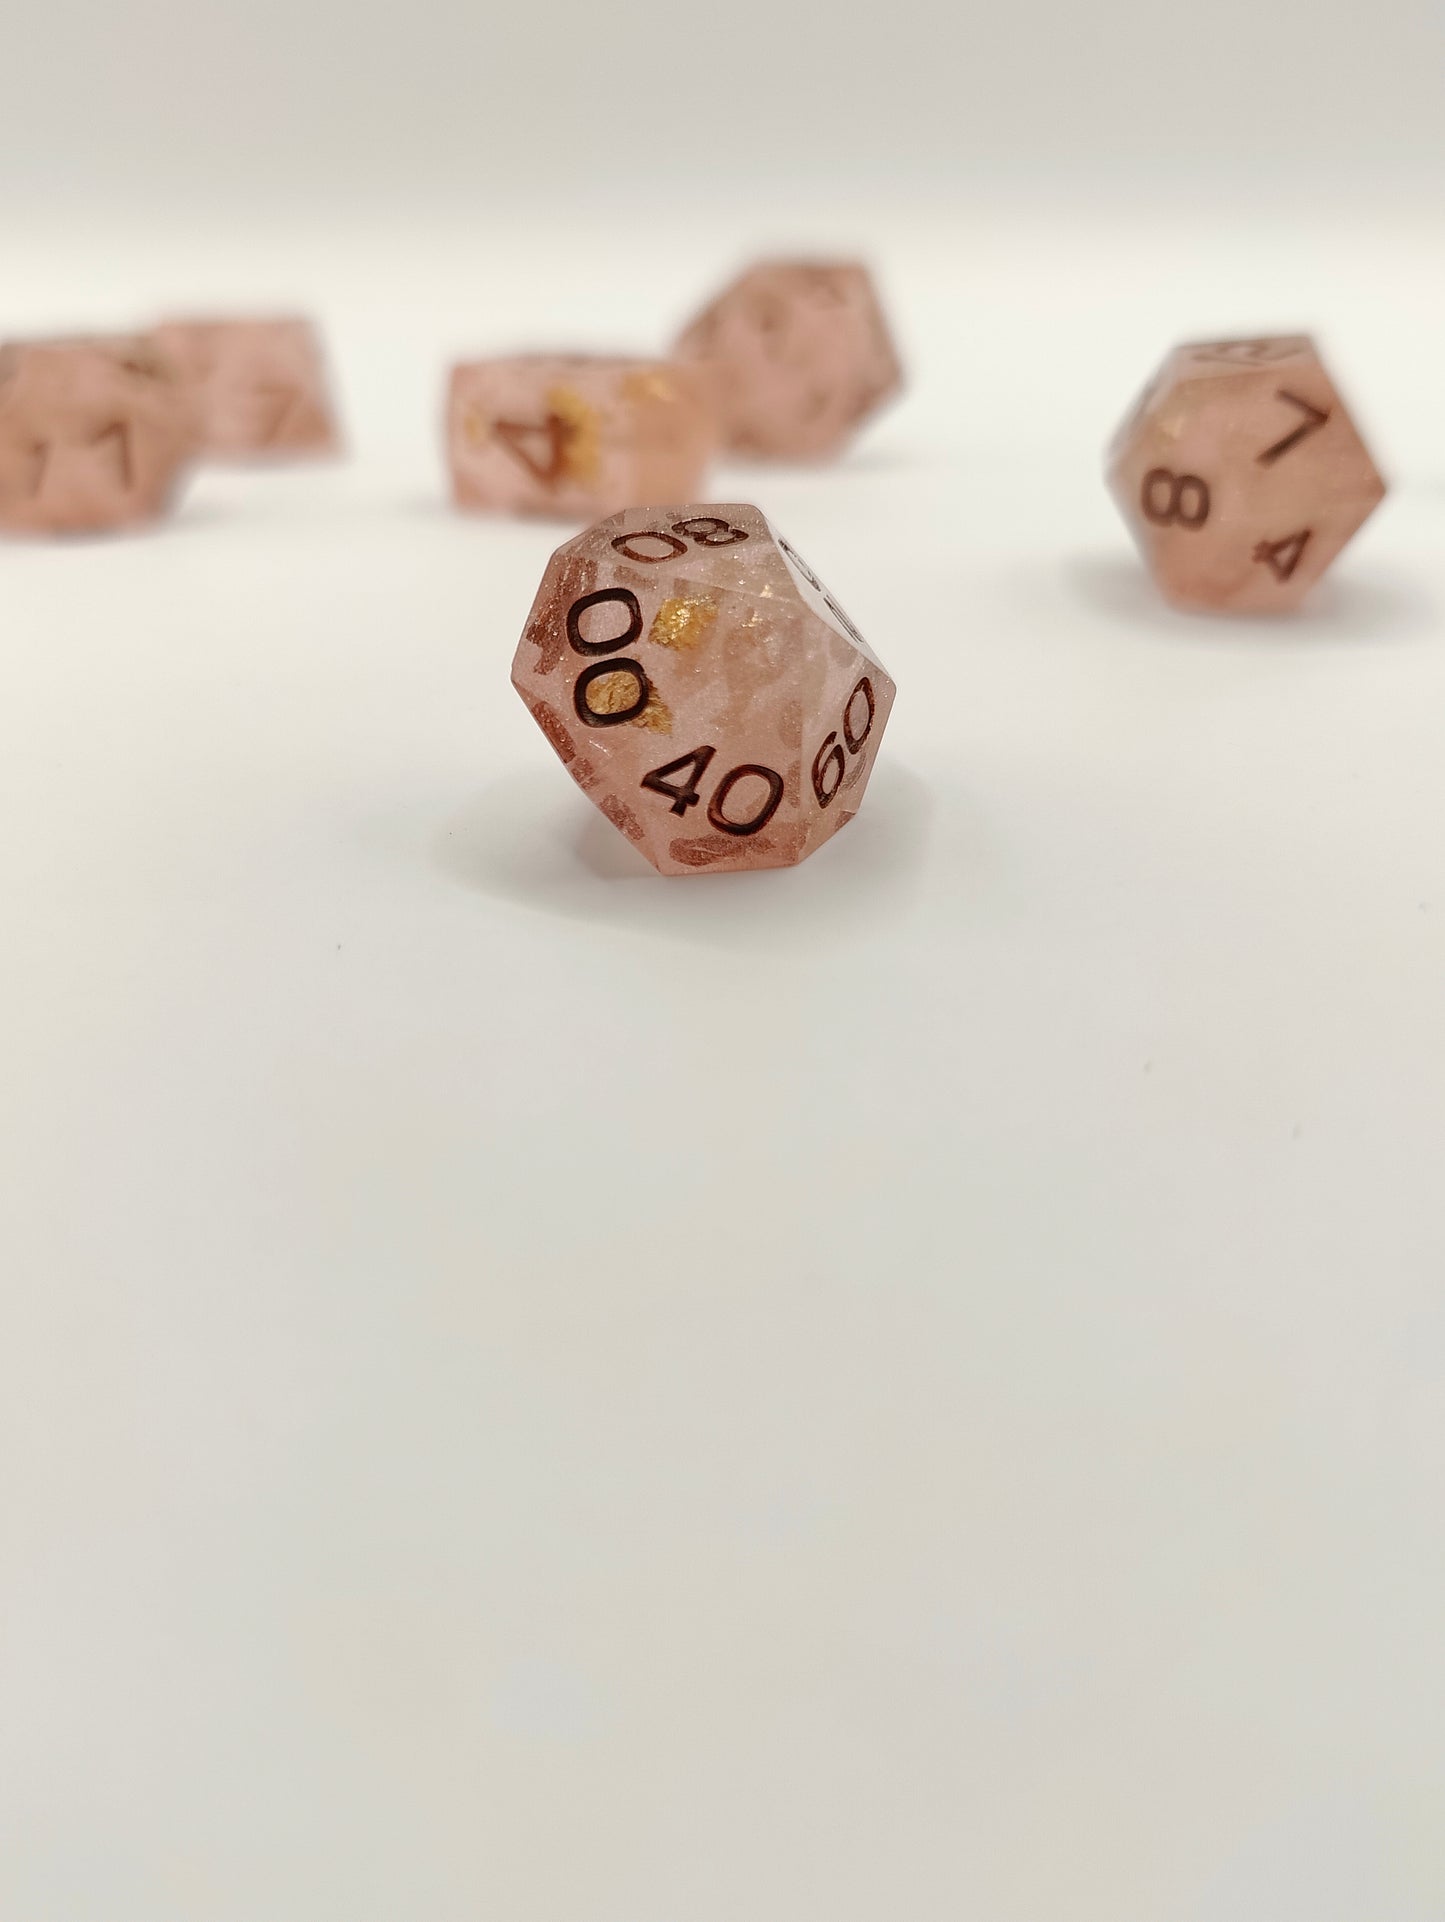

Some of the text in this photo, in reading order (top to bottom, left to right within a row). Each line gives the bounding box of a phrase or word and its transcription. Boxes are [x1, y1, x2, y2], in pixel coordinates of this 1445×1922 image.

[1256, 389, 1331, 467] 7
[1140, 467, 1211, 532] 8
[611, 517, 749, 564] 80
[1252, 528, 1312, 583] 4
[566, 587, 649, 728] 00
[812, 677, 875, 809] 60
[640, 745, 785, 836] 40
